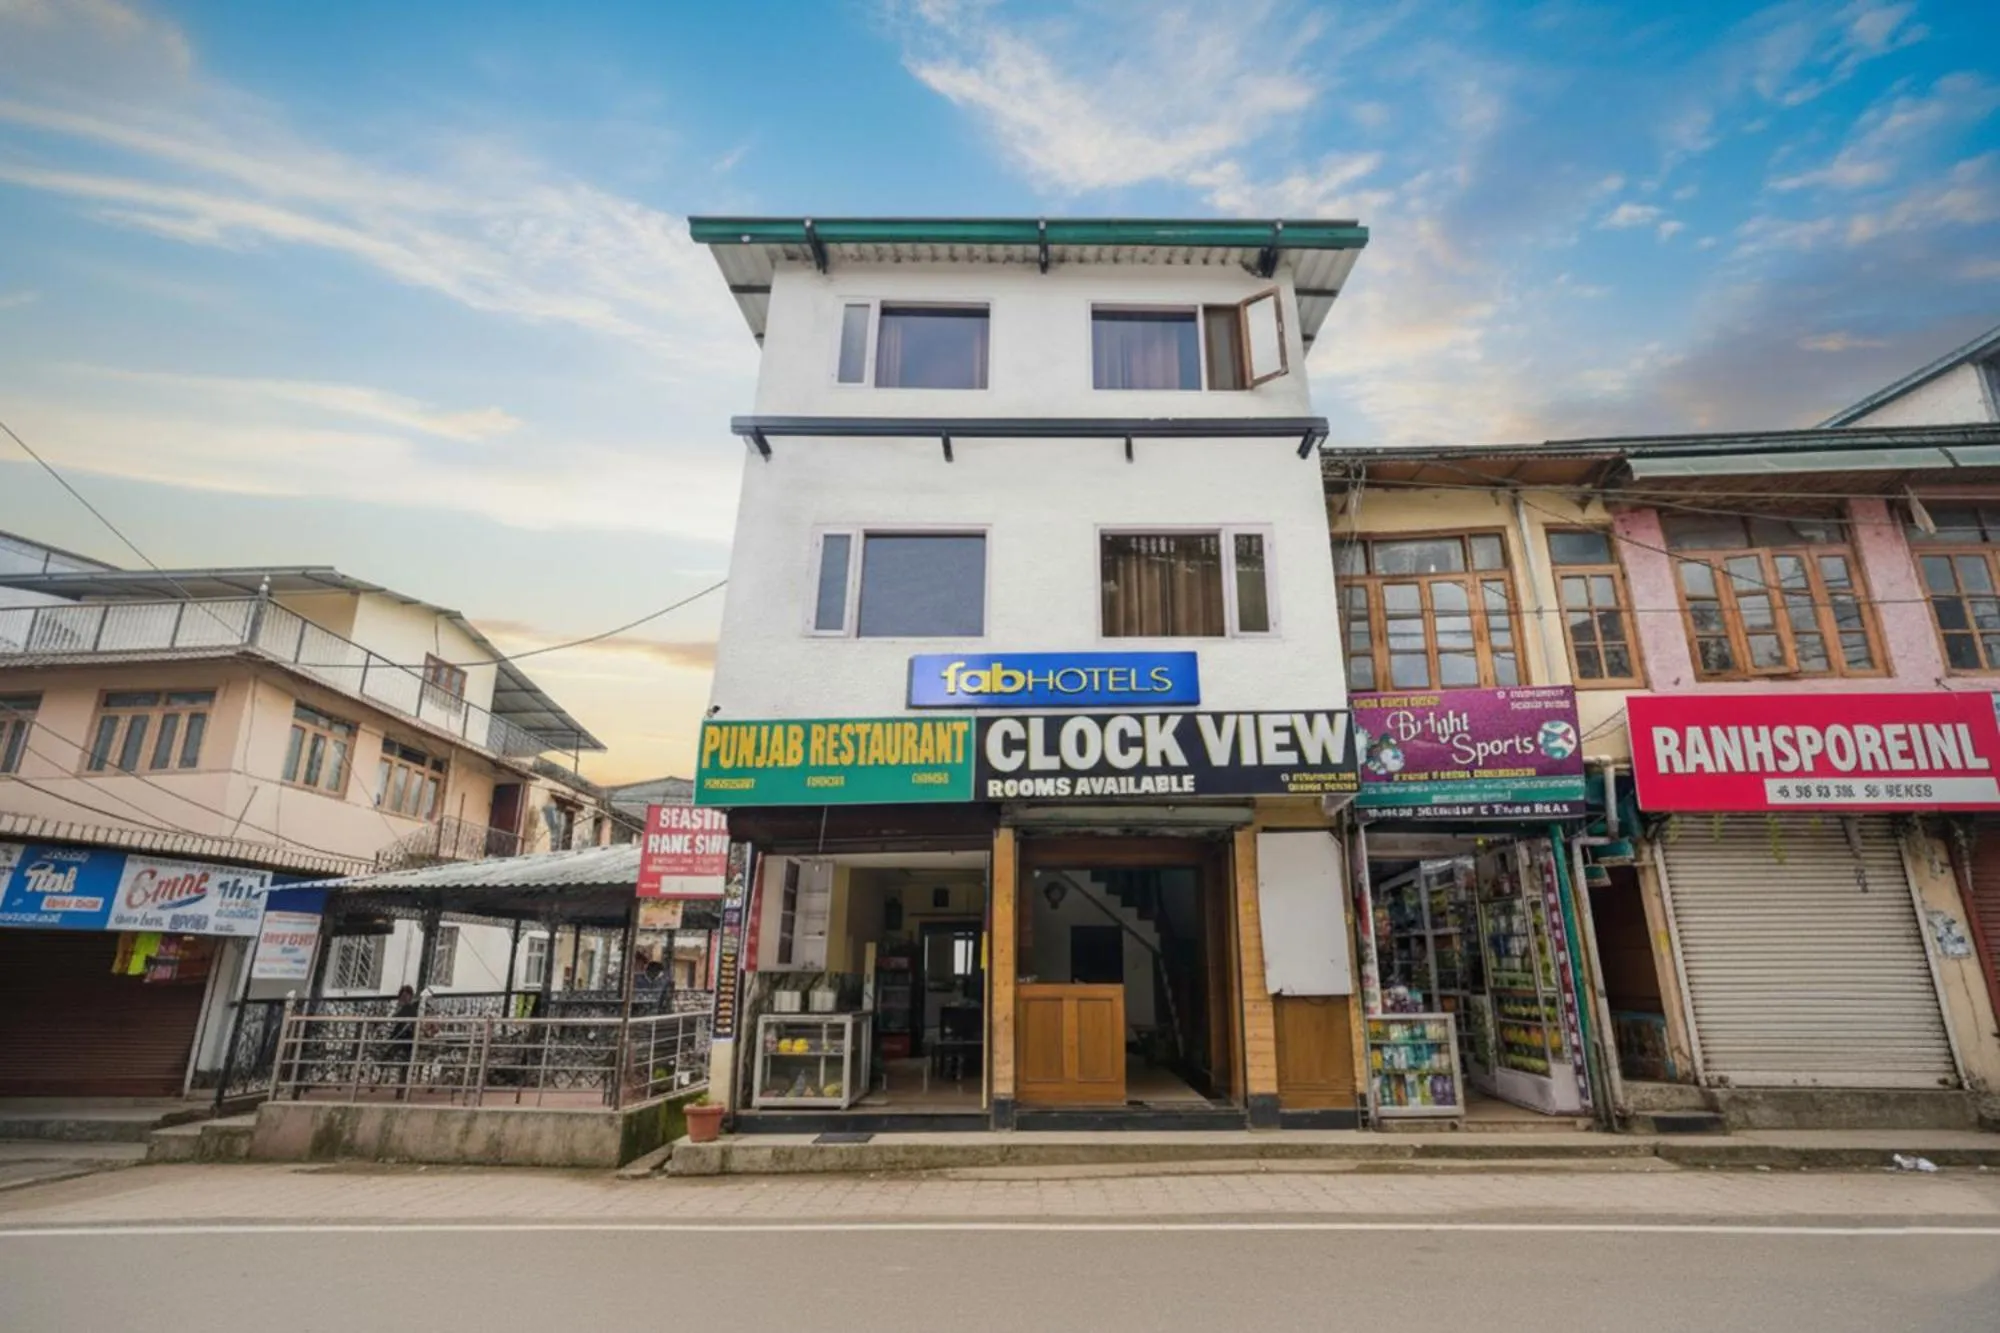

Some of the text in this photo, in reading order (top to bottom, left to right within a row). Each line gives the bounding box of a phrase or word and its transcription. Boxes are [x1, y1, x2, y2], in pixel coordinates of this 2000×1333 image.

[701, 721, 969, 769] PUNJAB RESTAURANT
[985, 712, 1348, 772] CLOCK VIEW
[1452, 733, 1535, 766] Sports
[1651, 723, 1990, 774] RANHSPOREINL
[986, 775, 1195, 798] ROOMS AVAILABLE
